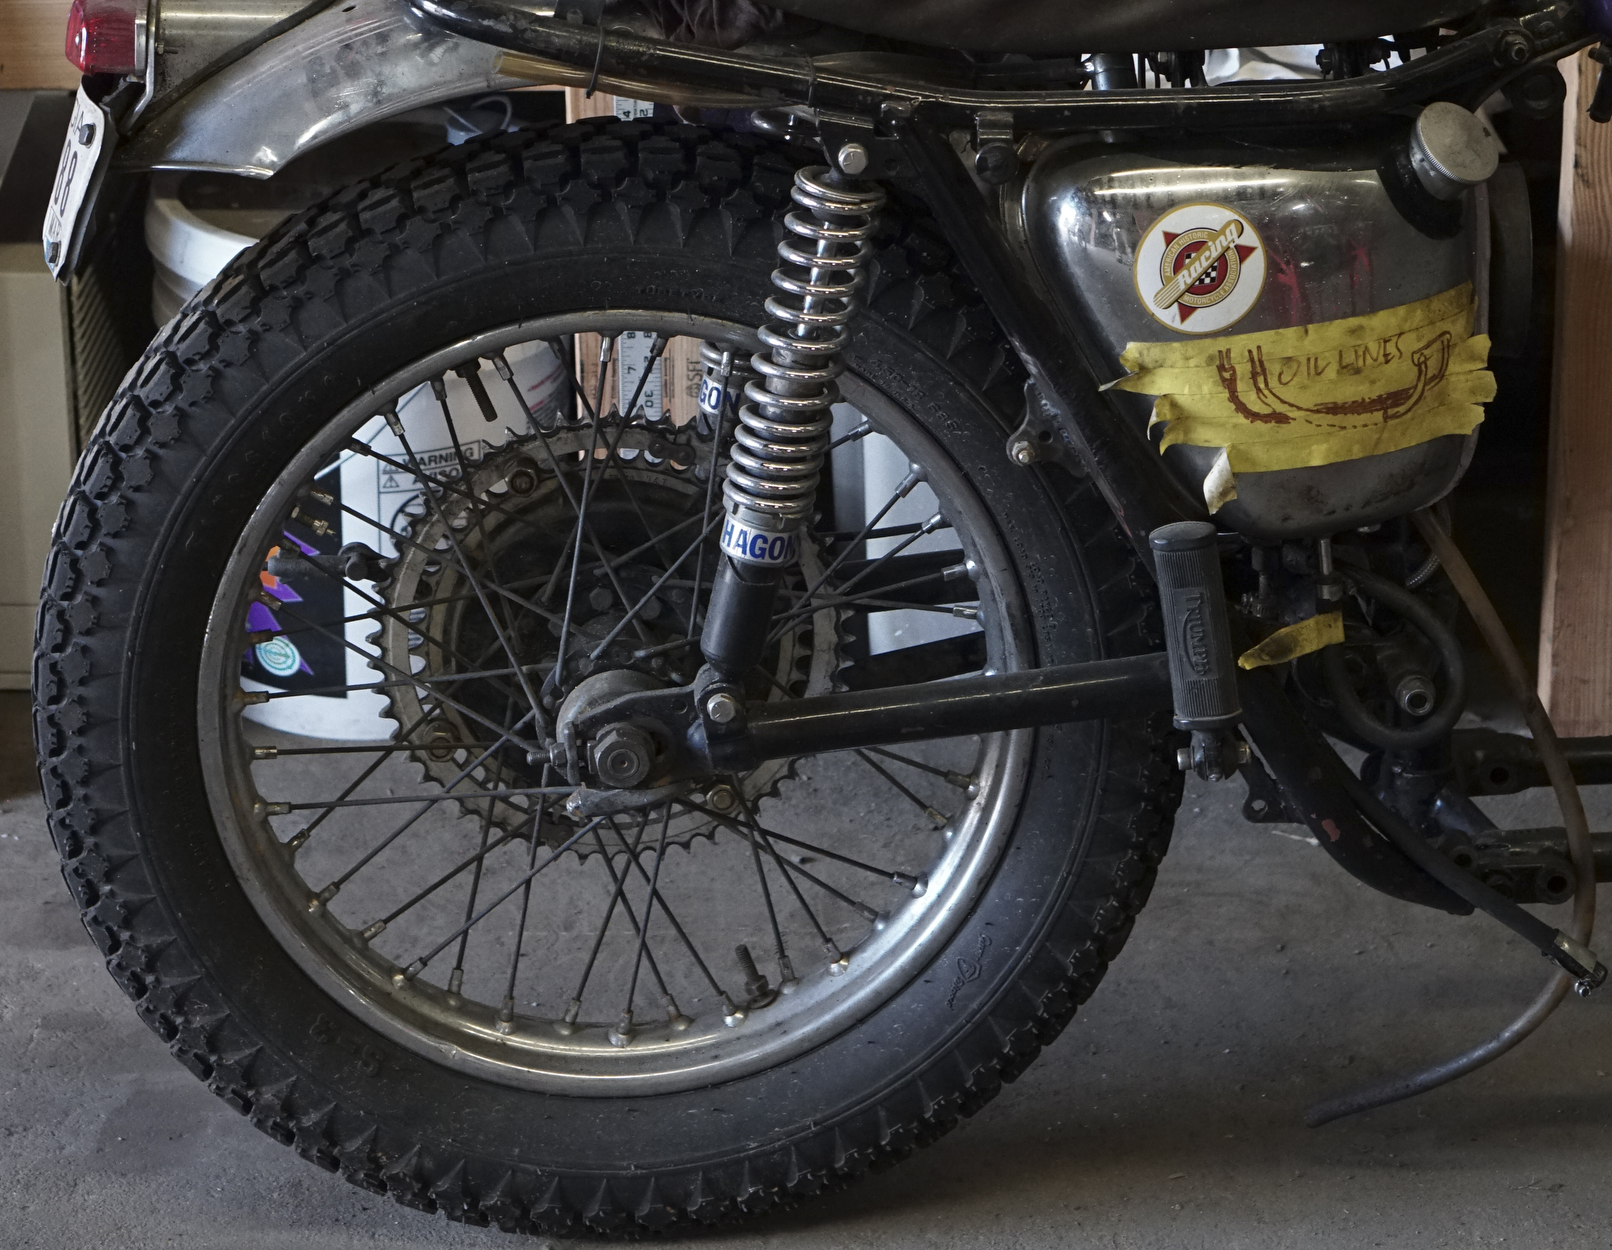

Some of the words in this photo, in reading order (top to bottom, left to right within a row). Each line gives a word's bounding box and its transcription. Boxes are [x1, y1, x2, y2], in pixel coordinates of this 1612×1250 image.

[1164, 243, 1181, 277] AMERICAN
[1180, 231, 1209, 246] HISTORIC
[1178, 222, 1239, 291] Racing
[1183, 290, 1225, 305] MOTORCYCLE
[1225, 250, 1238, 293] ASSOCIATION
[1278, 356, 1332, 386] OIL
[1339, 331, 1406, 370] LINES
[645, 390, 653, 408] 30
[402, 447, 475, 467] WARNIG
[722, 519, 797, 561] HAGON
